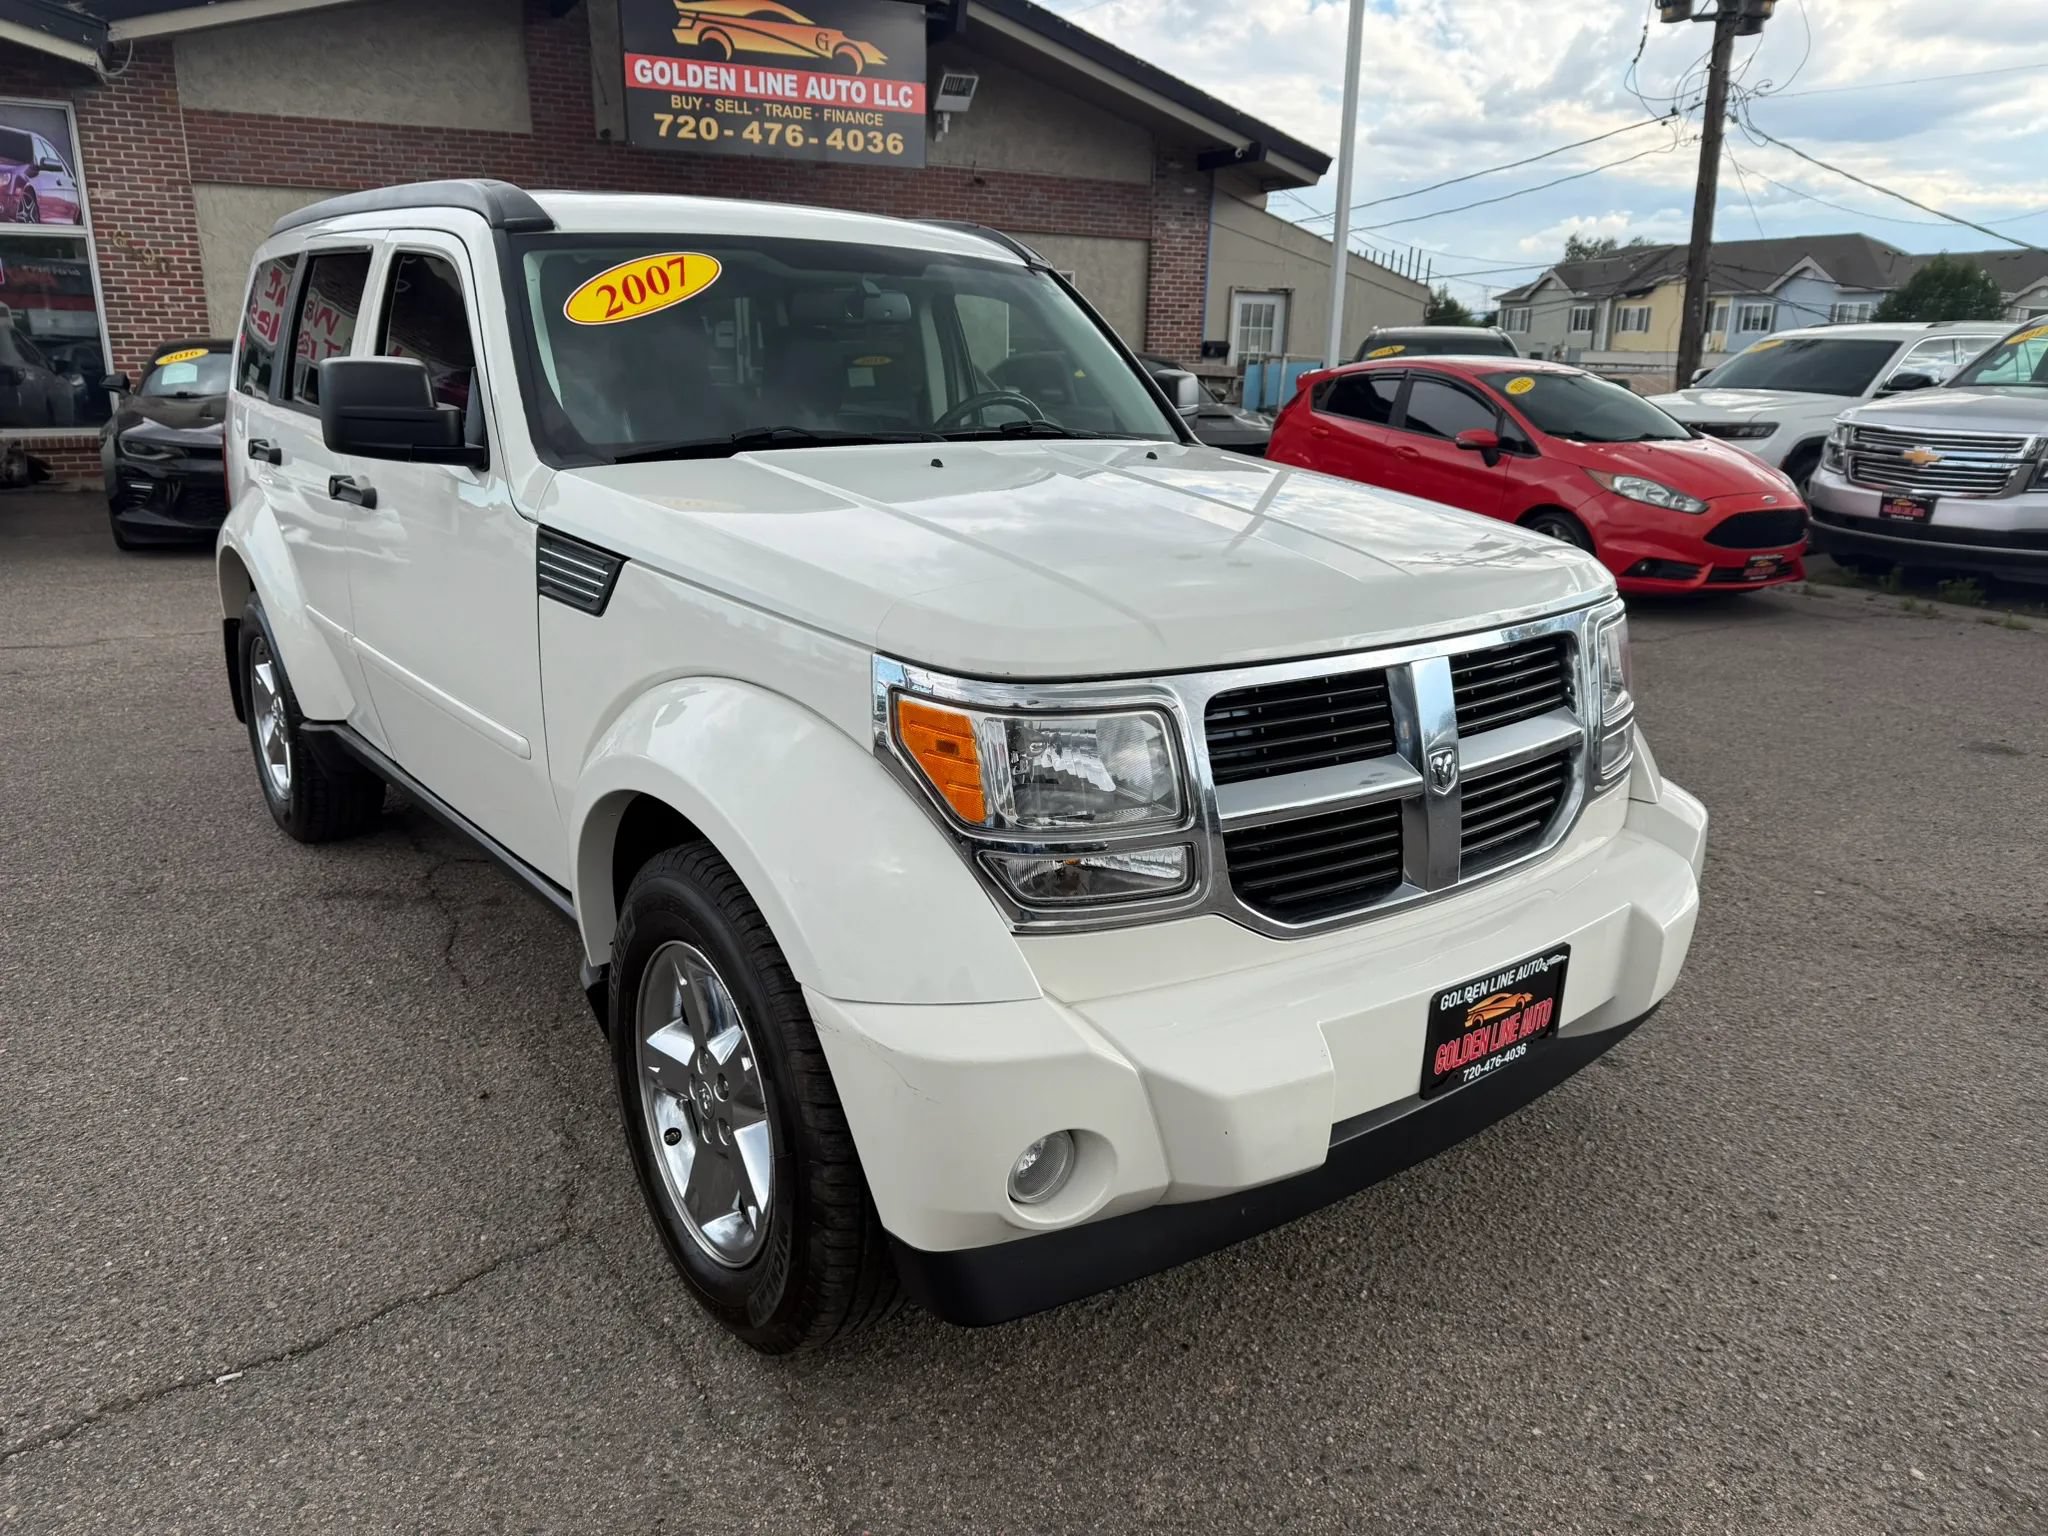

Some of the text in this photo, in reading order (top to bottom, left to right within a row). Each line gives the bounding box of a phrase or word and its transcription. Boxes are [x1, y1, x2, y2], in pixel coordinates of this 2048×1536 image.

[634, 59, 913, 109] GOLDEN LINE AUTO LLC
[671, 94, 884, 127] BUY SELL TRADE FINANCE
[595, 255, 686, 319] 2007
[1440, 957, 1544, 1011] GOLDEN LINE AUTO
[1434, 997, 1553, 1075] GOLDEN LINE AUTO
[1463, 1043, 1527, 1082] 720-476-4036
